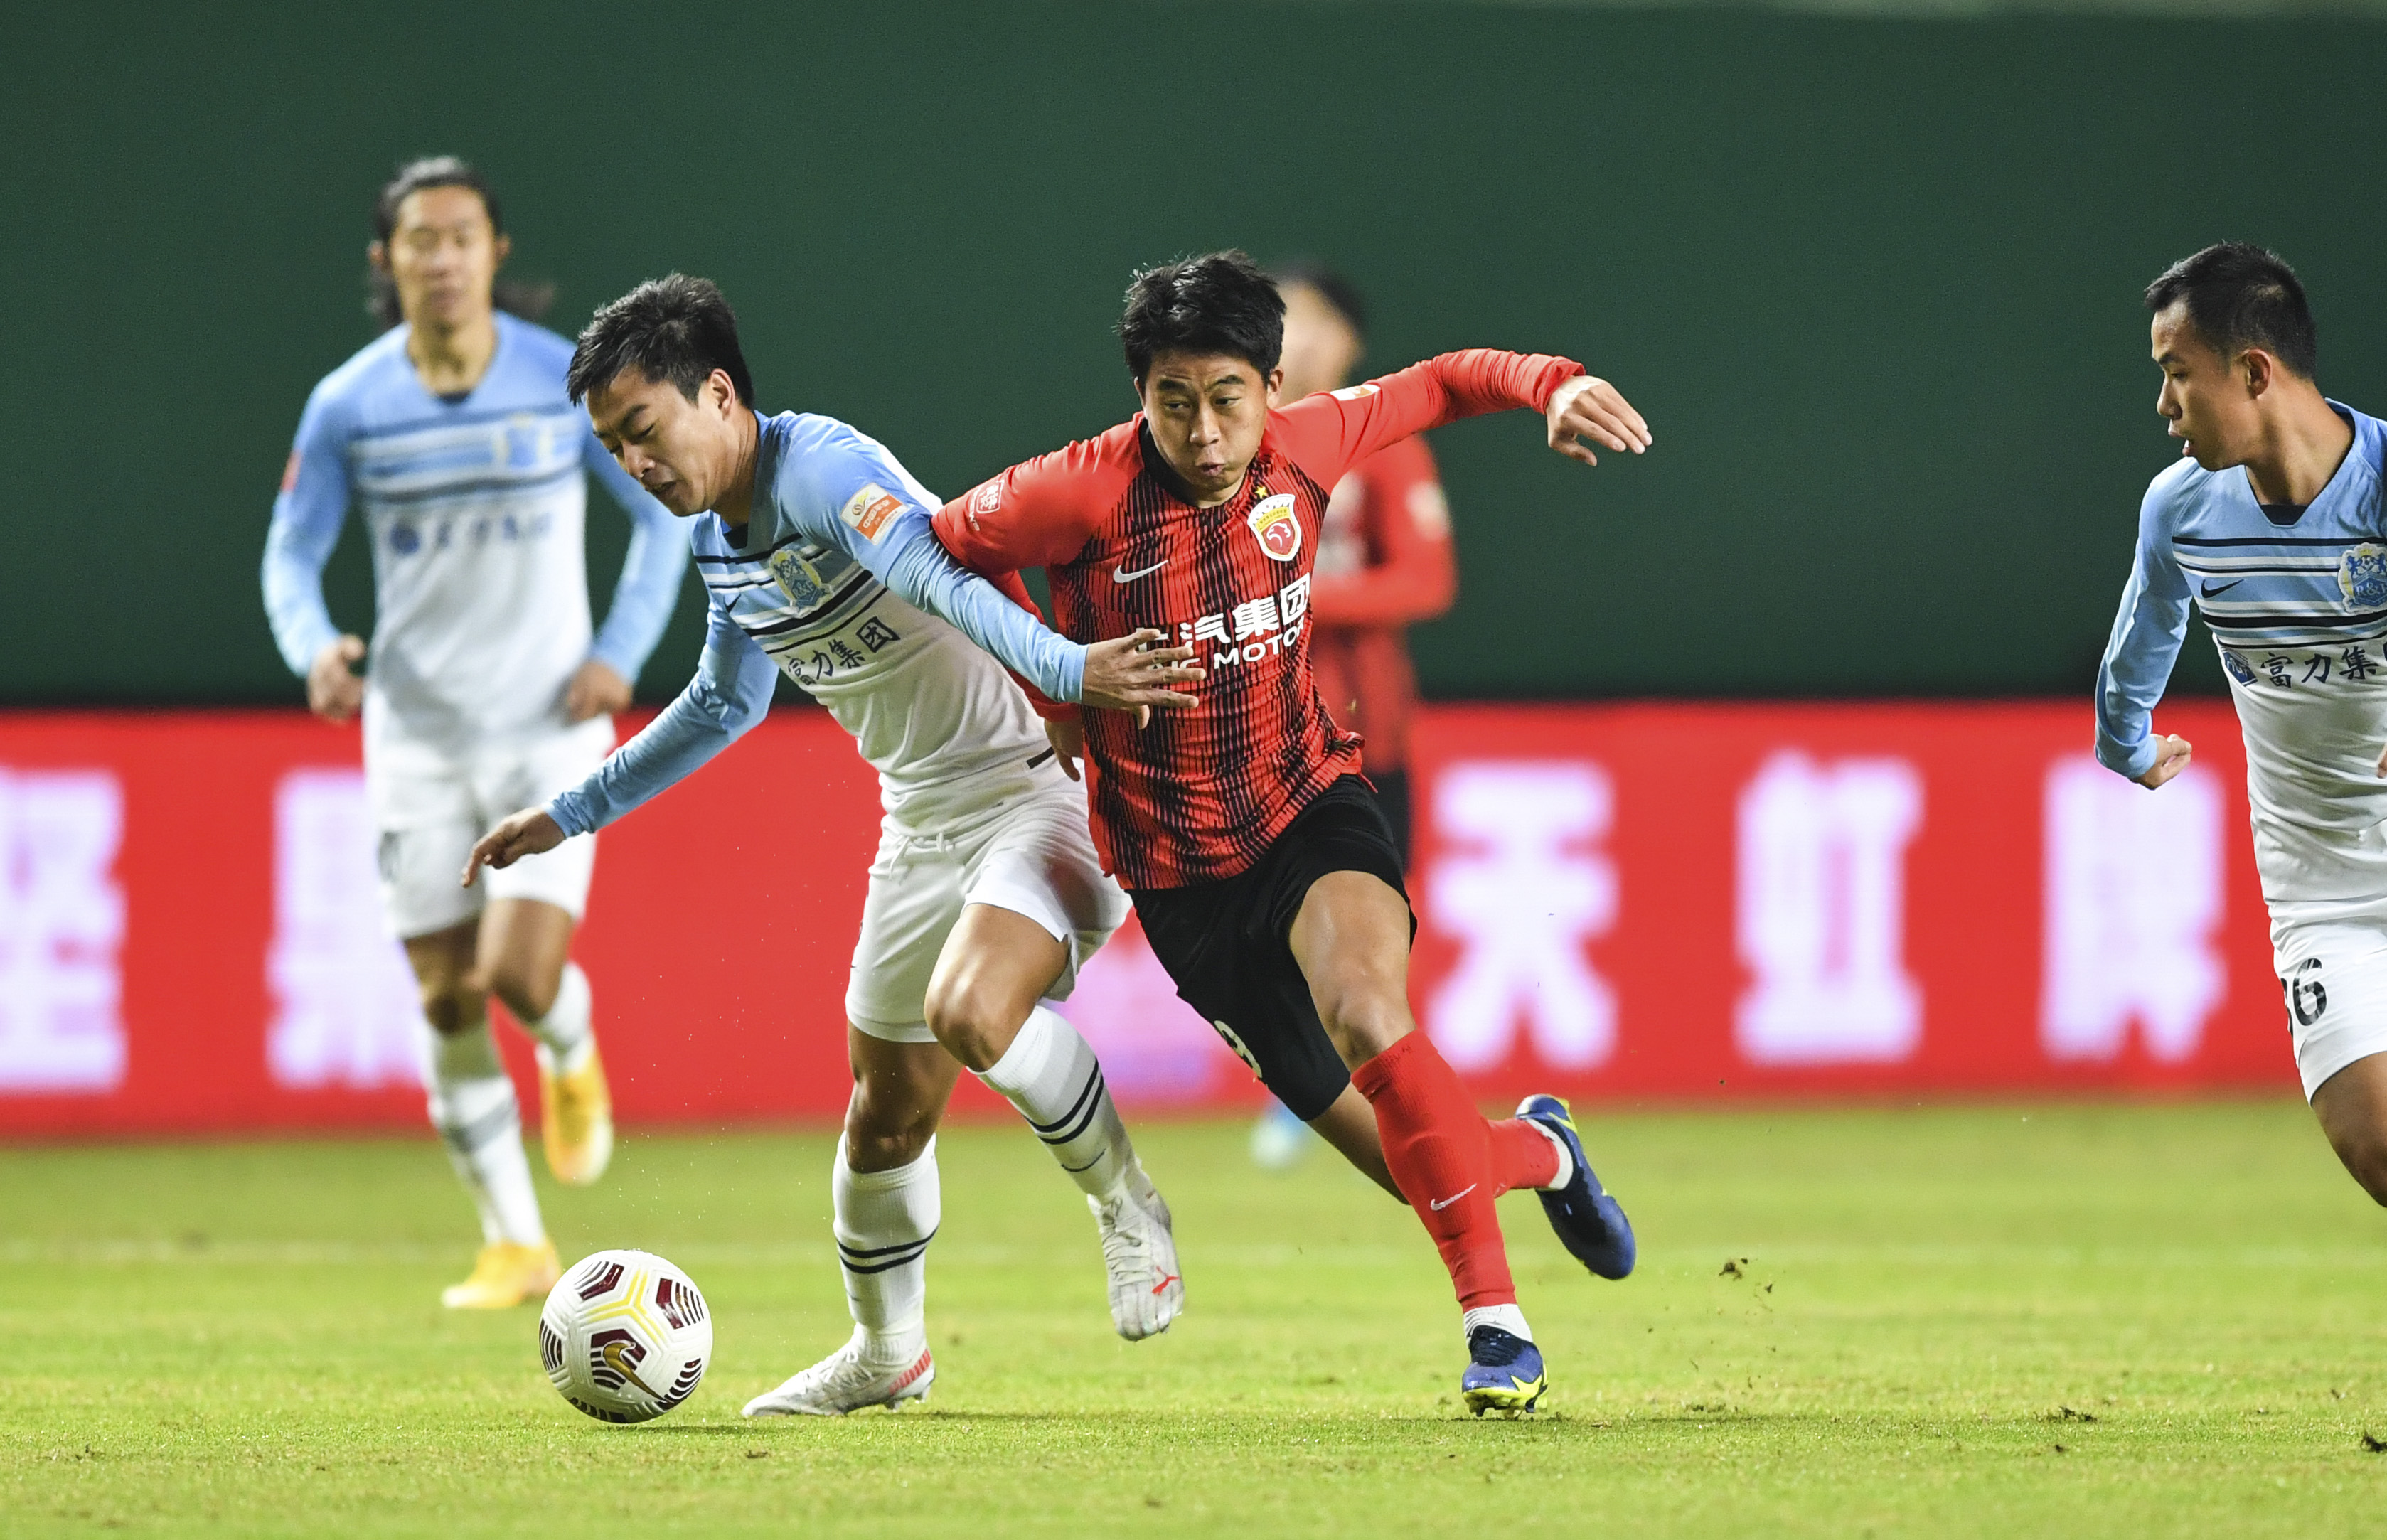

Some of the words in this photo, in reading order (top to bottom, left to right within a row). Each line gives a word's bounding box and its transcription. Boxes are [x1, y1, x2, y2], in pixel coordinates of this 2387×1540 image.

[784, 616, 901, 686] 富力集团
[2260, 642, 2387, 688] 富力集
